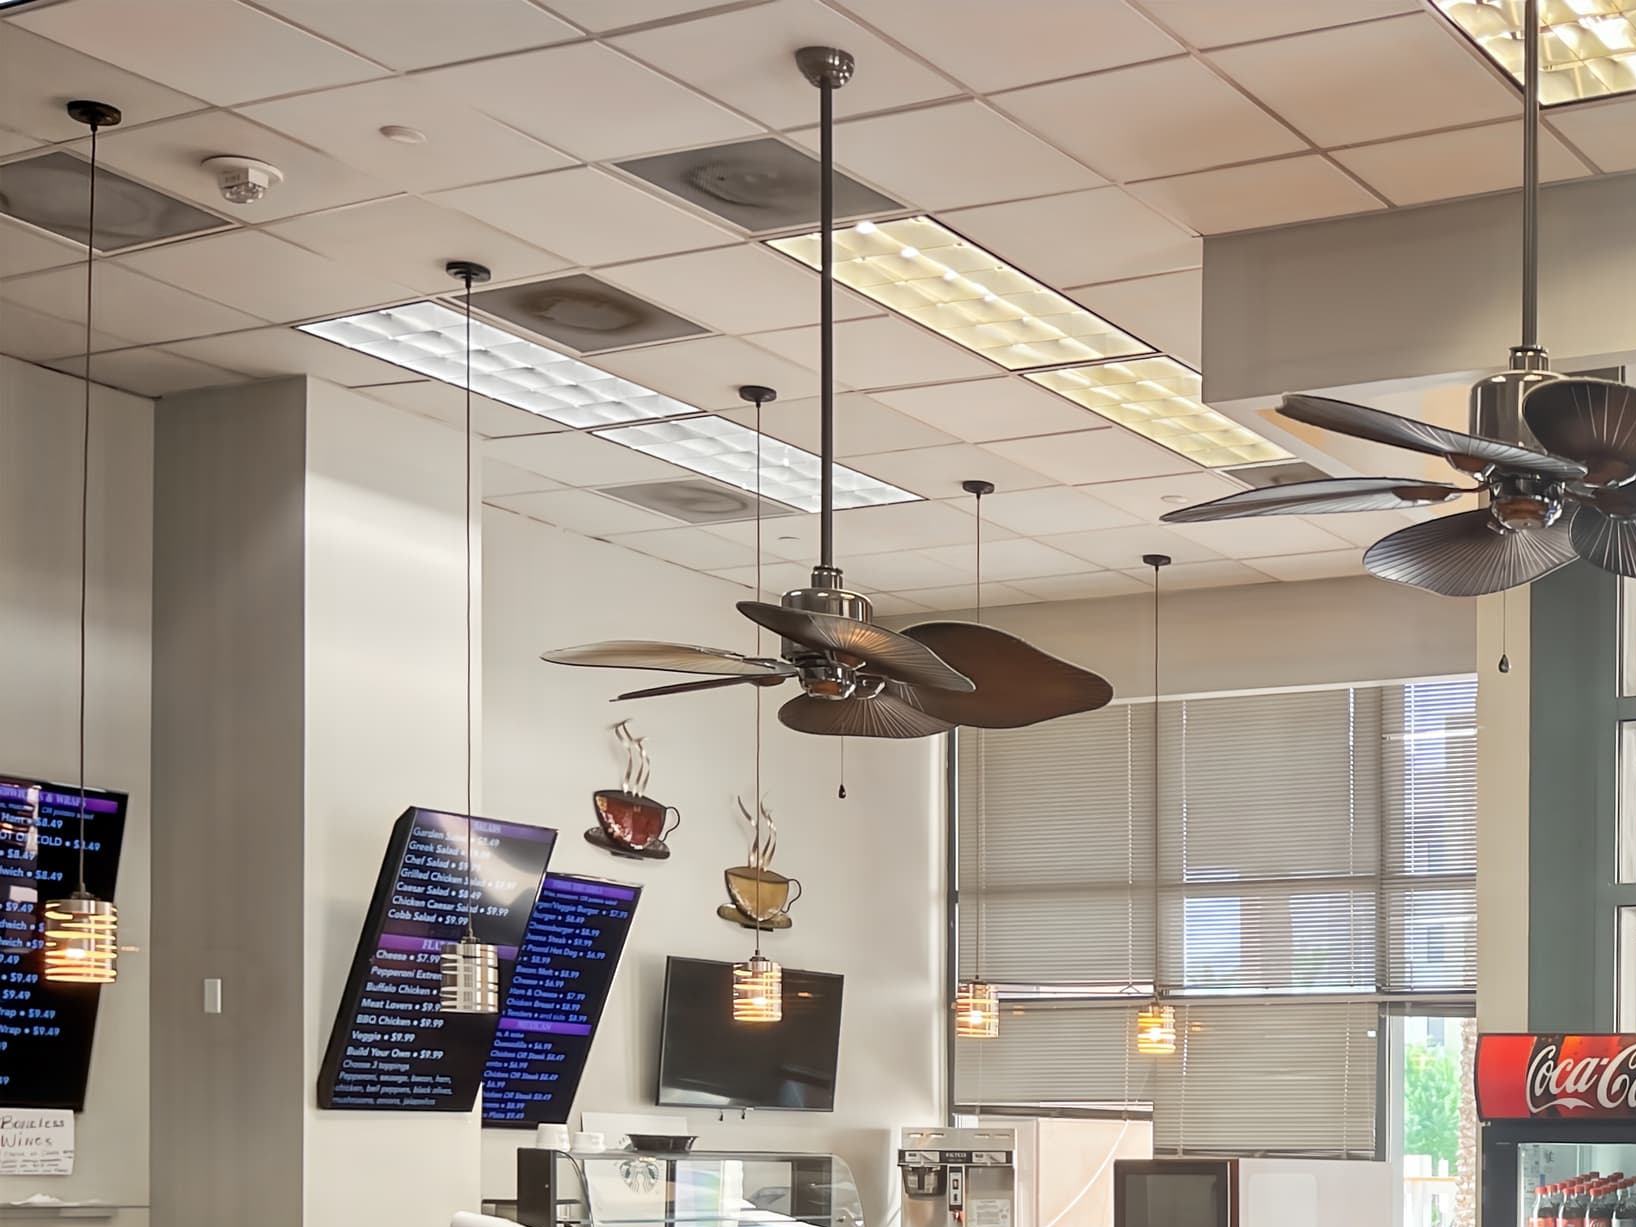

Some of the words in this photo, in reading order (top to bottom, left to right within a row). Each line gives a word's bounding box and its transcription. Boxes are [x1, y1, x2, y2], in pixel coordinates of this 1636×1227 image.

[413, 827, 444, 840] Garden
[409, 841, 434, 853] Greek
[436, 845, 459, 856] Salad
[404, 854, 425, 866] Chef
[426, 858, 449, 869] Salad
[400, 868, 429, 881] Grilled
[430, 872, 463, 884] Chicken
[396, 882, 425, 894] Caesar
[426, 885, 449, 897] Salad
[392, 896, 425, 908] Chicken
[427, 900, 454, 911] Caesar
[388, 909, 412, 920] Cobb
[413, 912, 436, 923] Salad
[376, 950, 407, 961] Cheese
[416, 953, 441, 964] $7.99
[10, 972, 38, 983] $9.49
[370, 966, 415, 980] Pepperoni
[366, 982, 396, 994] Buffalo
[398, 984, 431, 995] Chicken
[361, 998, 384, 1009] Meat
[385, 1000, 413, 1011] Lovers
[356, 1014, 377, 1025] BBQ
[378, 1016, 411, 1027] Chicken
[351, 1030, 381, 1043] Veggie
[346, 1046, 370, 1057] Build
[371, 1047, 391, 1058] Your
[391, 1048, 411, 1059] Own
